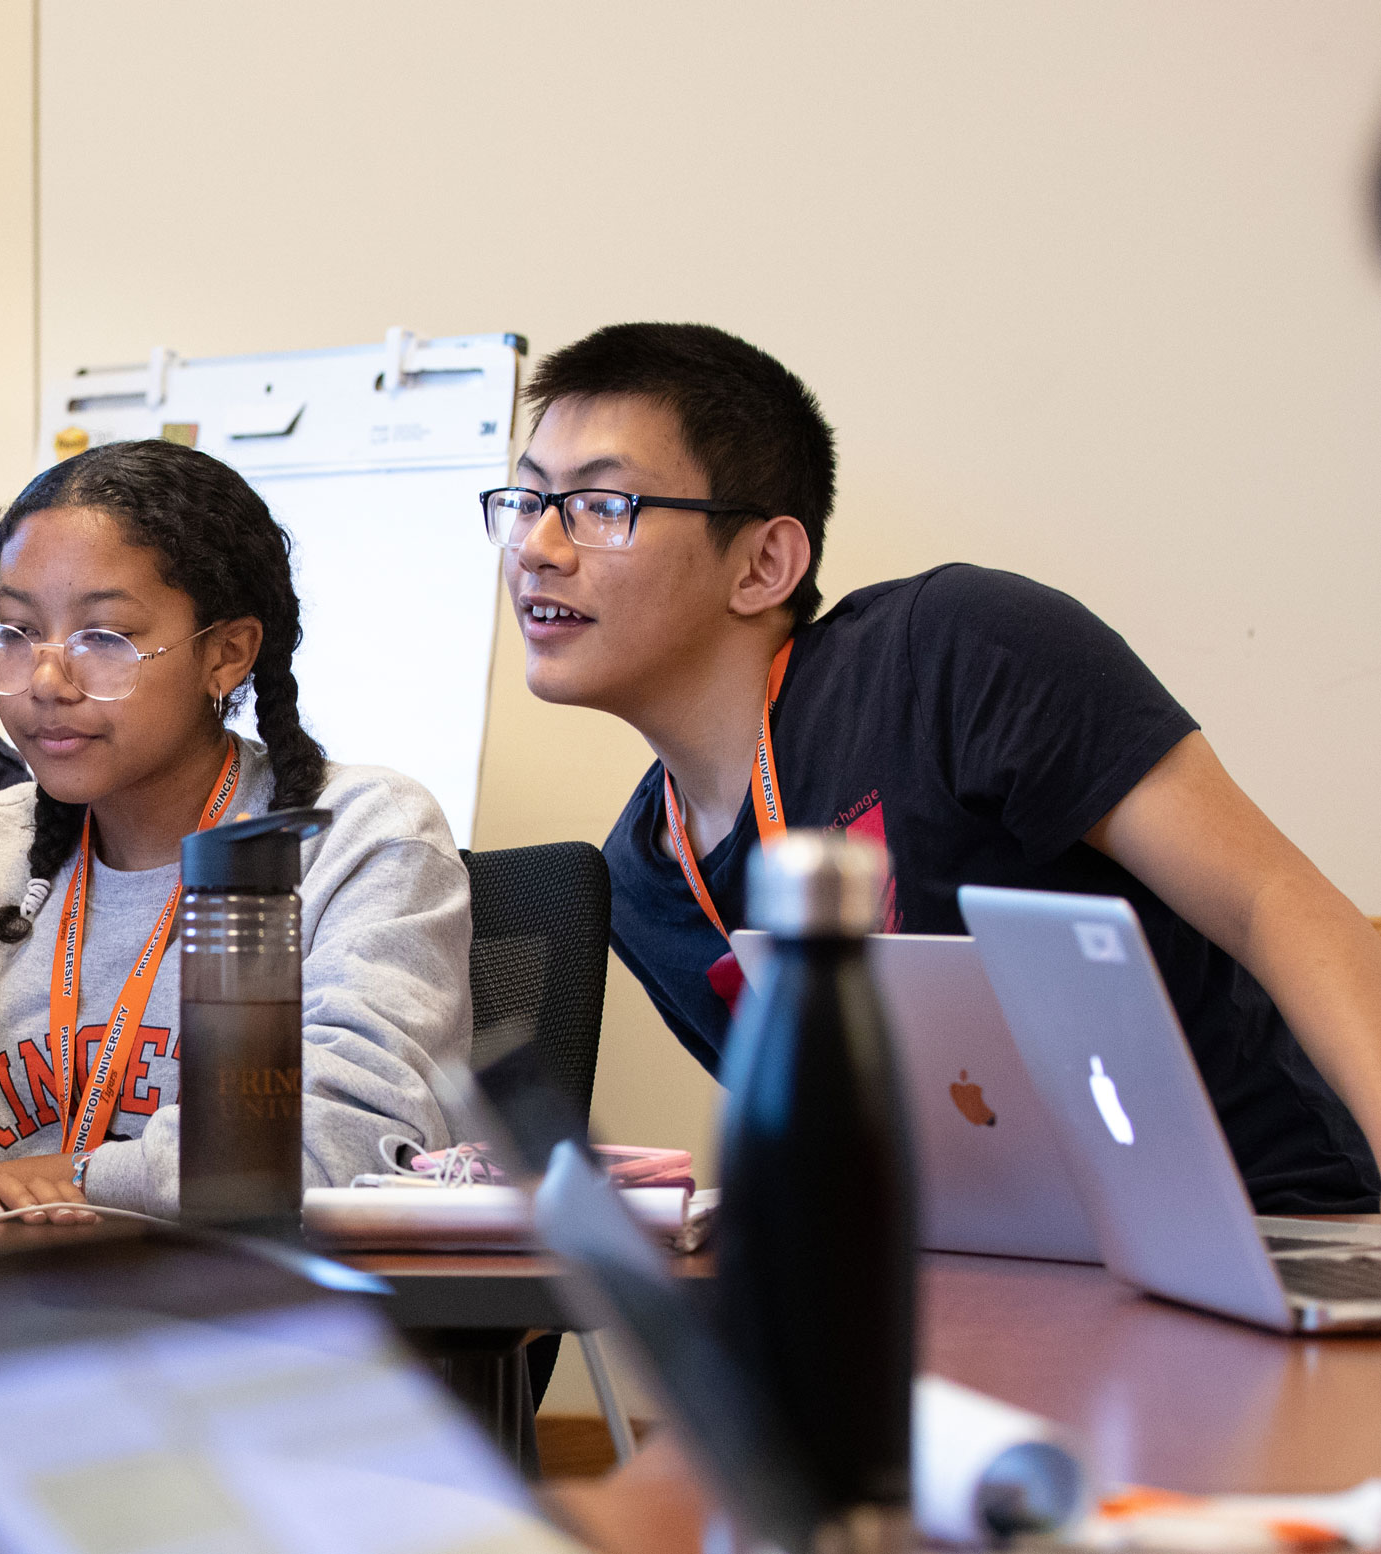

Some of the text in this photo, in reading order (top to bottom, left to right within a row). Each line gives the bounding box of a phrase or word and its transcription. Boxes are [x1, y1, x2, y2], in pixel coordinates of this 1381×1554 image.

[208, 757, 241, 819] PRINCETON
[757, 741, 779, 823] UNIVERSITY
[62, 849, 85, 998] PRINCETON UNIVERSITY
[134, 907, 171, 979] PRINCETON
[60, 1025, 69, 1102] PRINCETON
[73, 1004, 130, 1153] RINCETON UNIVERSITY
